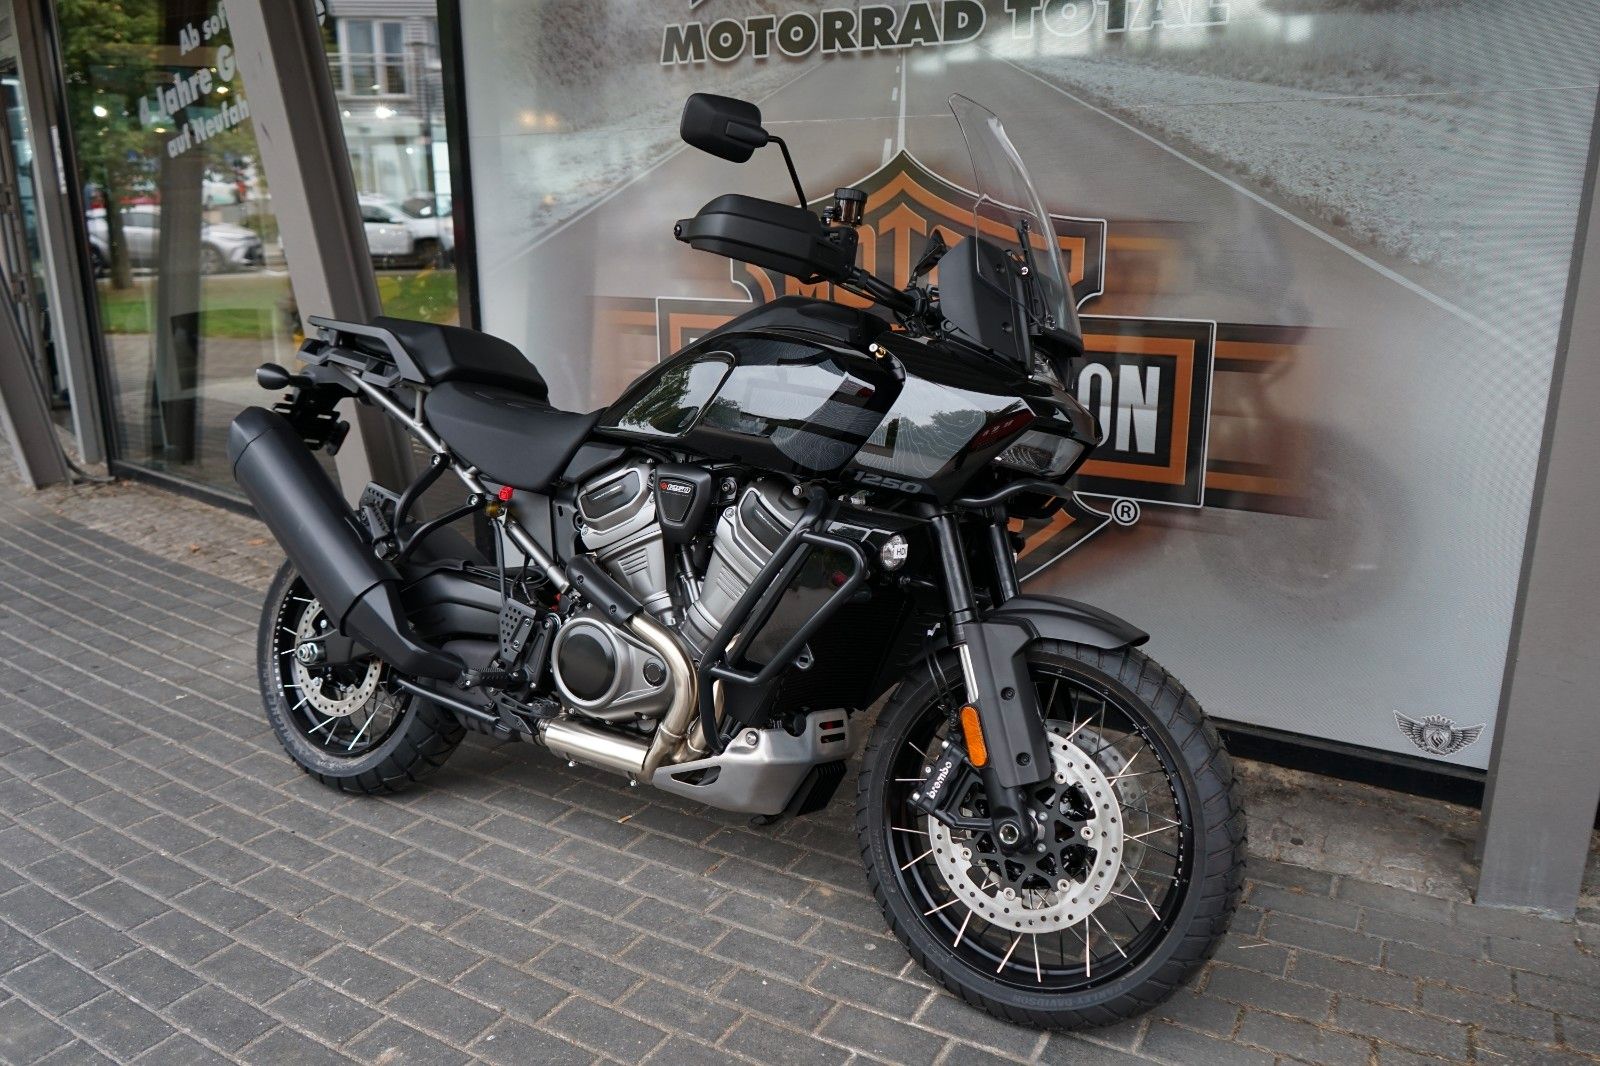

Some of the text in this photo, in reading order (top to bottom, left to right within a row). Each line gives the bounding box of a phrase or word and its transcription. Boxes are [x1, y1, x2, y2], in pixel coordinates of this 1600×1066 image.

[179, 22, 200, 56] Ab
[660, 0, 986, 65] MOTORRAD
[156, 67, 213, 118] Jahre
[167, 122, 192, 158] auf
[854, 471, 923, 493] 1250
[926, 761, 952, 799] brembo
